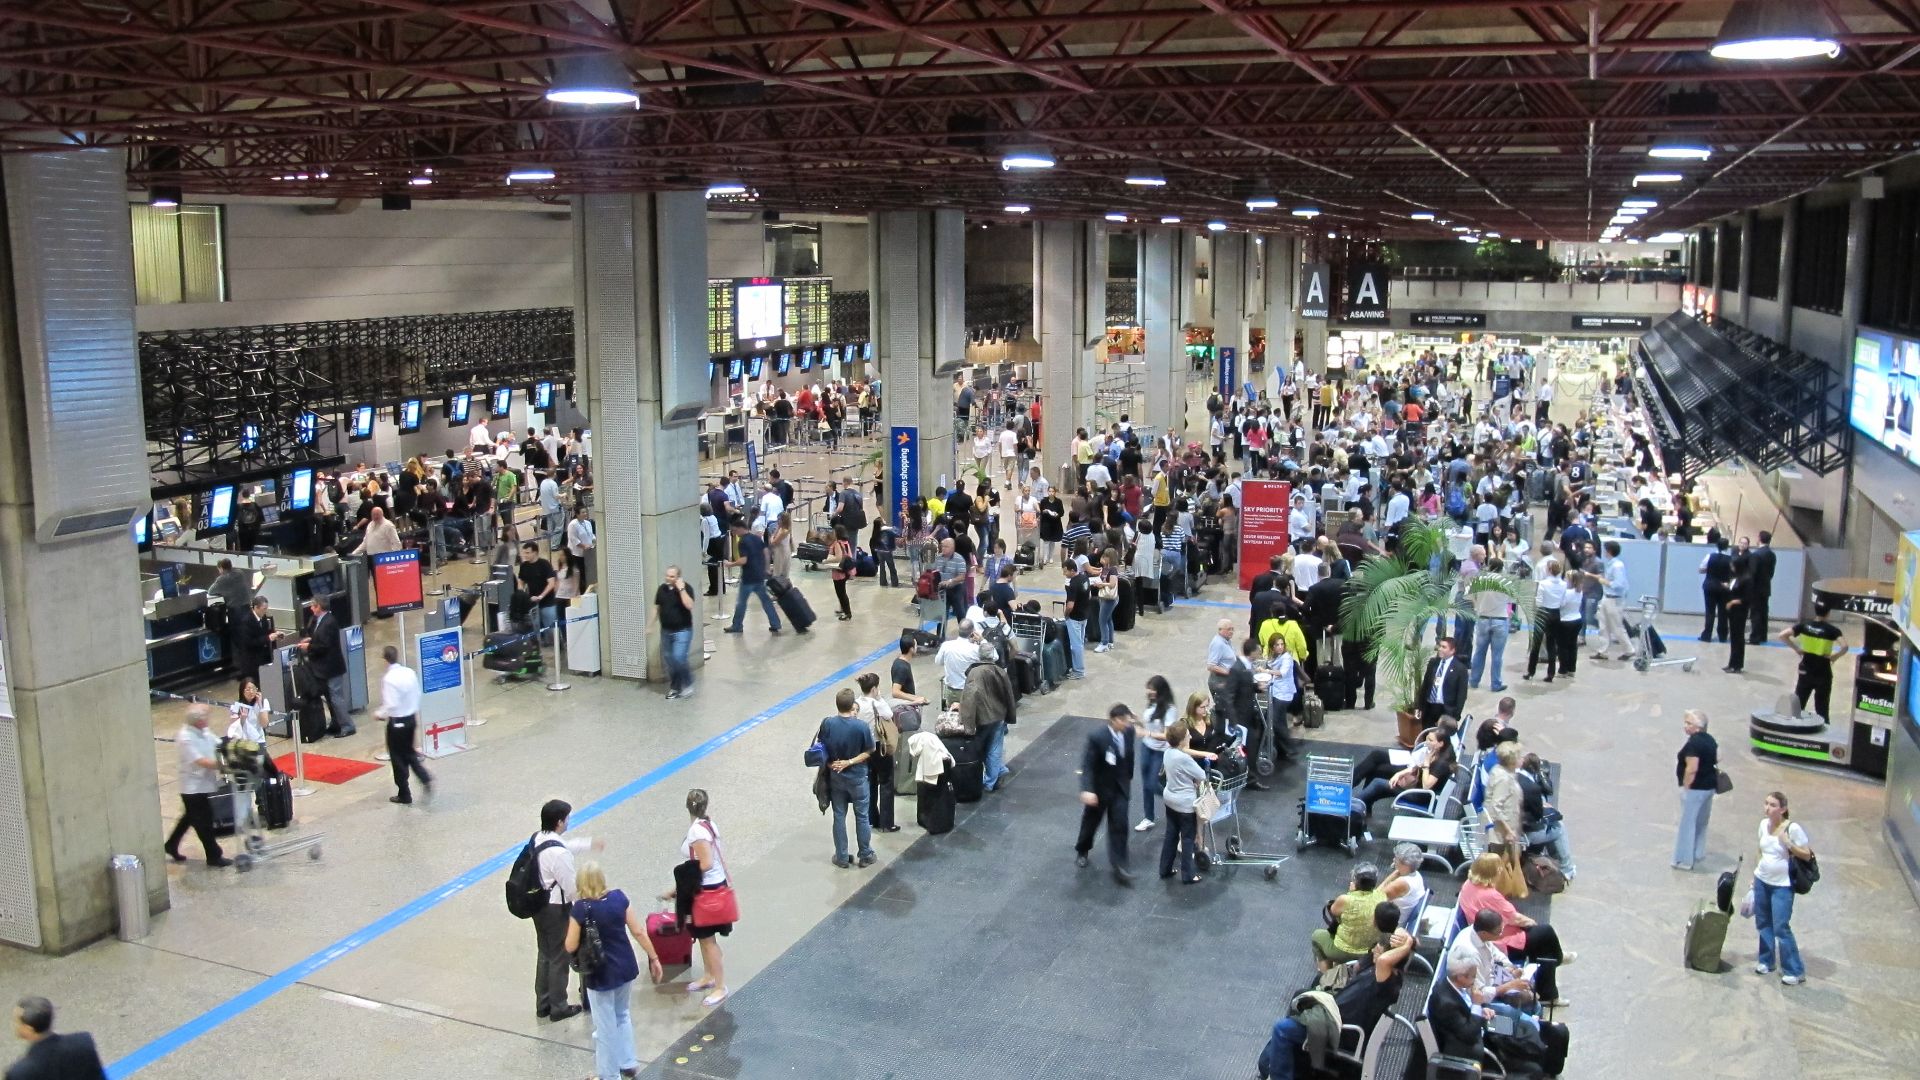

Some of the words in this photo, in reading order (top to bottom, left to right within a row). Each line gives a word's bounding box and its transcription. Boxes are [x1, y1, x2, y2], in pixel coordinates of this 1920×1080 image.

[1306, 272, 1324, 304] A
[1356, 272, 1379, 304] A
[1302, 309, 1328, 318] ASA/WING
[1350, 310, 1384, 318] ASA/WING
[352, 419, 356, 427] A
[349, 428, 357, 436] 09
[899, 448, 910, 479] shopping
[1572, 467, 1580, 478] 8
[283, 488, 290, 499] A
[201, 506, 208, 517] A
[281, 502, 291, 512] 04
[197, 520, 209, 531] 03
[385, 554, 415, 562] UNITED
